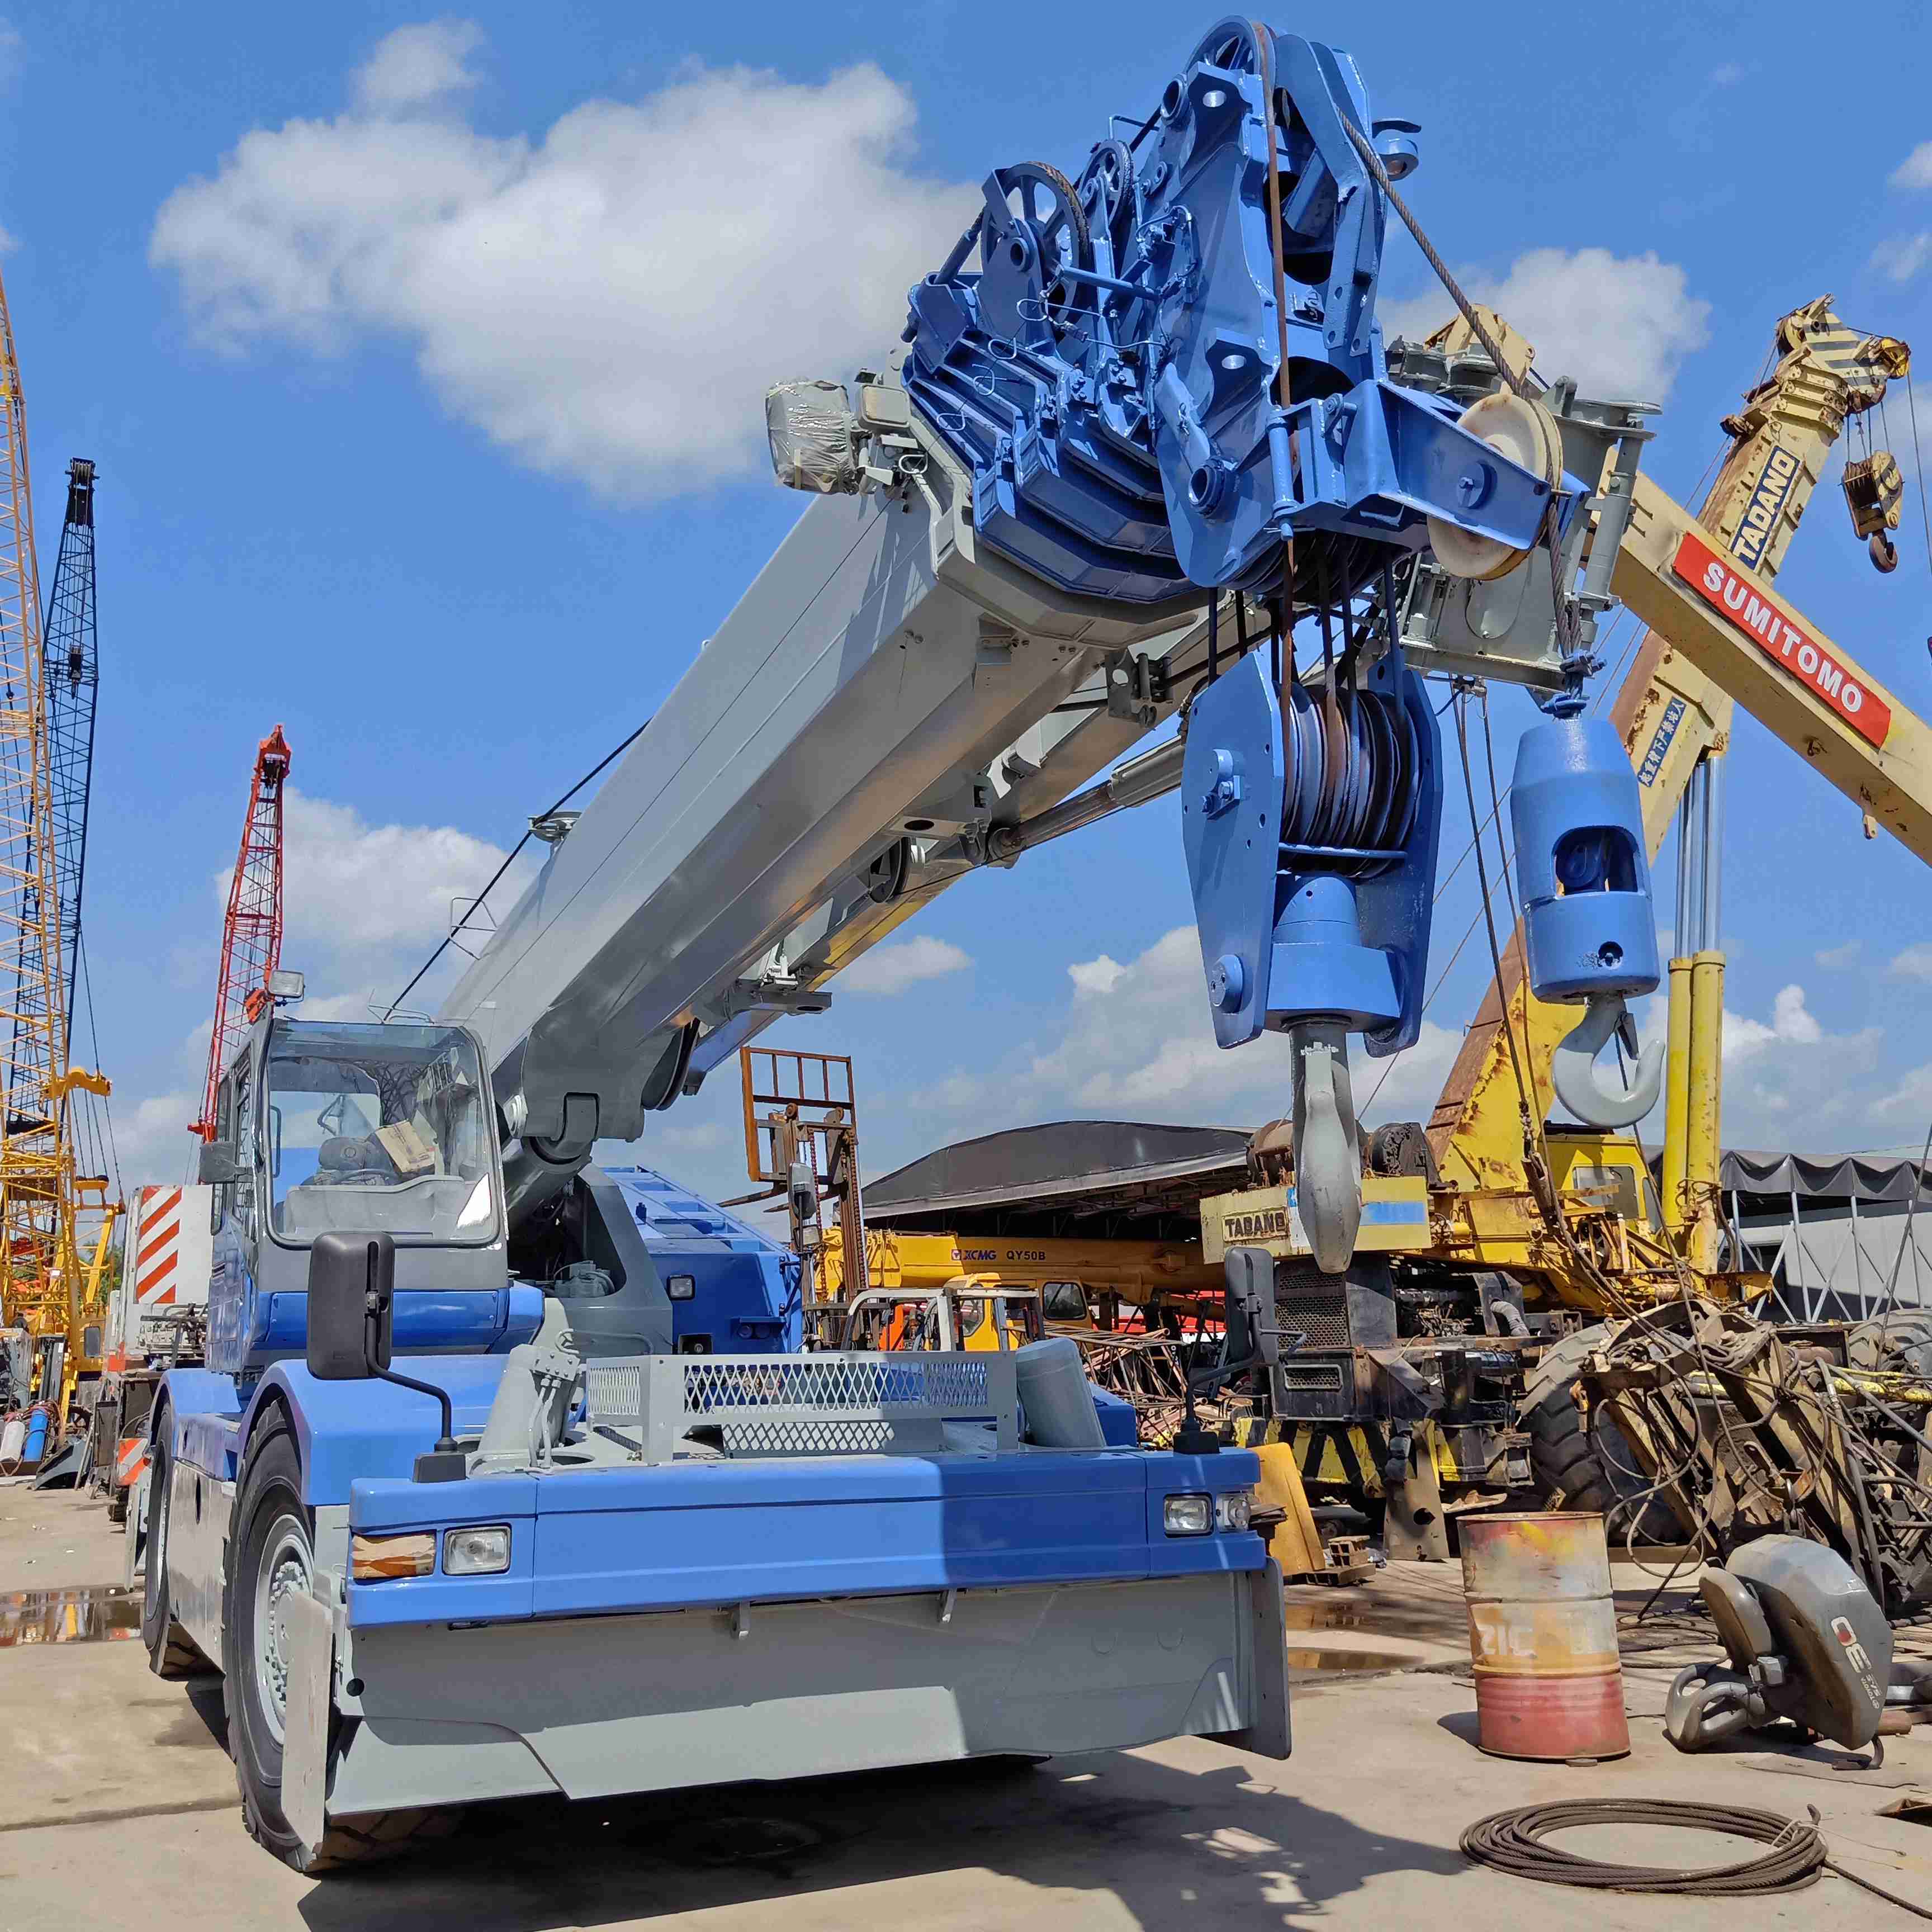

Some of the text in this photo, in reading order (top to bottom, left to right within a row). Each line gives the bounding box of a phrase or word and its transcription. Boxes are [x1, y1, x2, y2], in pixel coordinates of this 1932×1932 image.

[1732, 451, 1795, 561] TADANO
[1703, 562, 1862, 713] SUMITOMO
[964, 1250, 1046, 1261] XCMG QY50B
